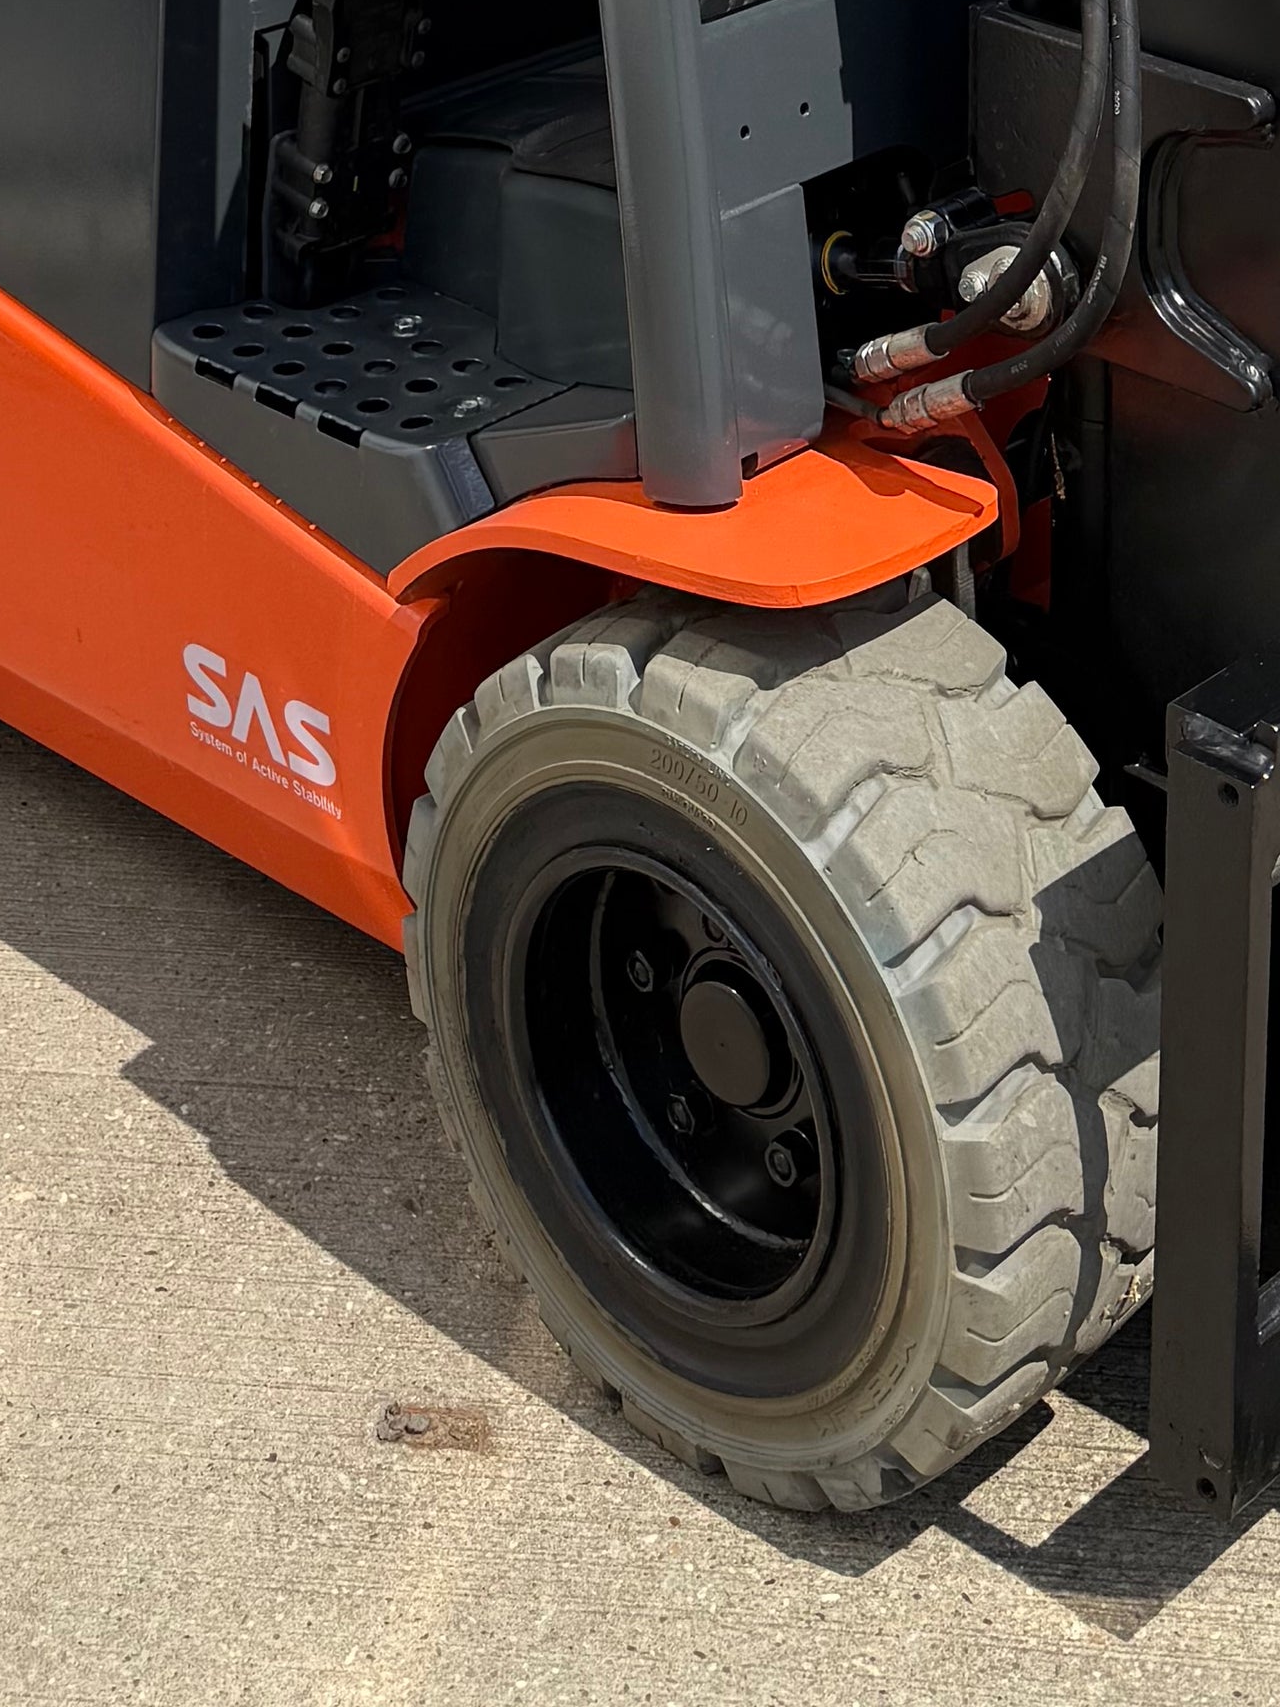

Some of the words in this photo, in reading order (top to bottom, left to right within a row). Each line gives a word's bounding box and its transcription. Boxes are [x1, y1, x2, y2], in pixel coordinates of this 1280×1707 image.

[182, 642, 337, 787] SAS
[189, 720, 233, 757] System
[252, 756, 289, 789] Active
[292, 779, 343, 820] Stability
